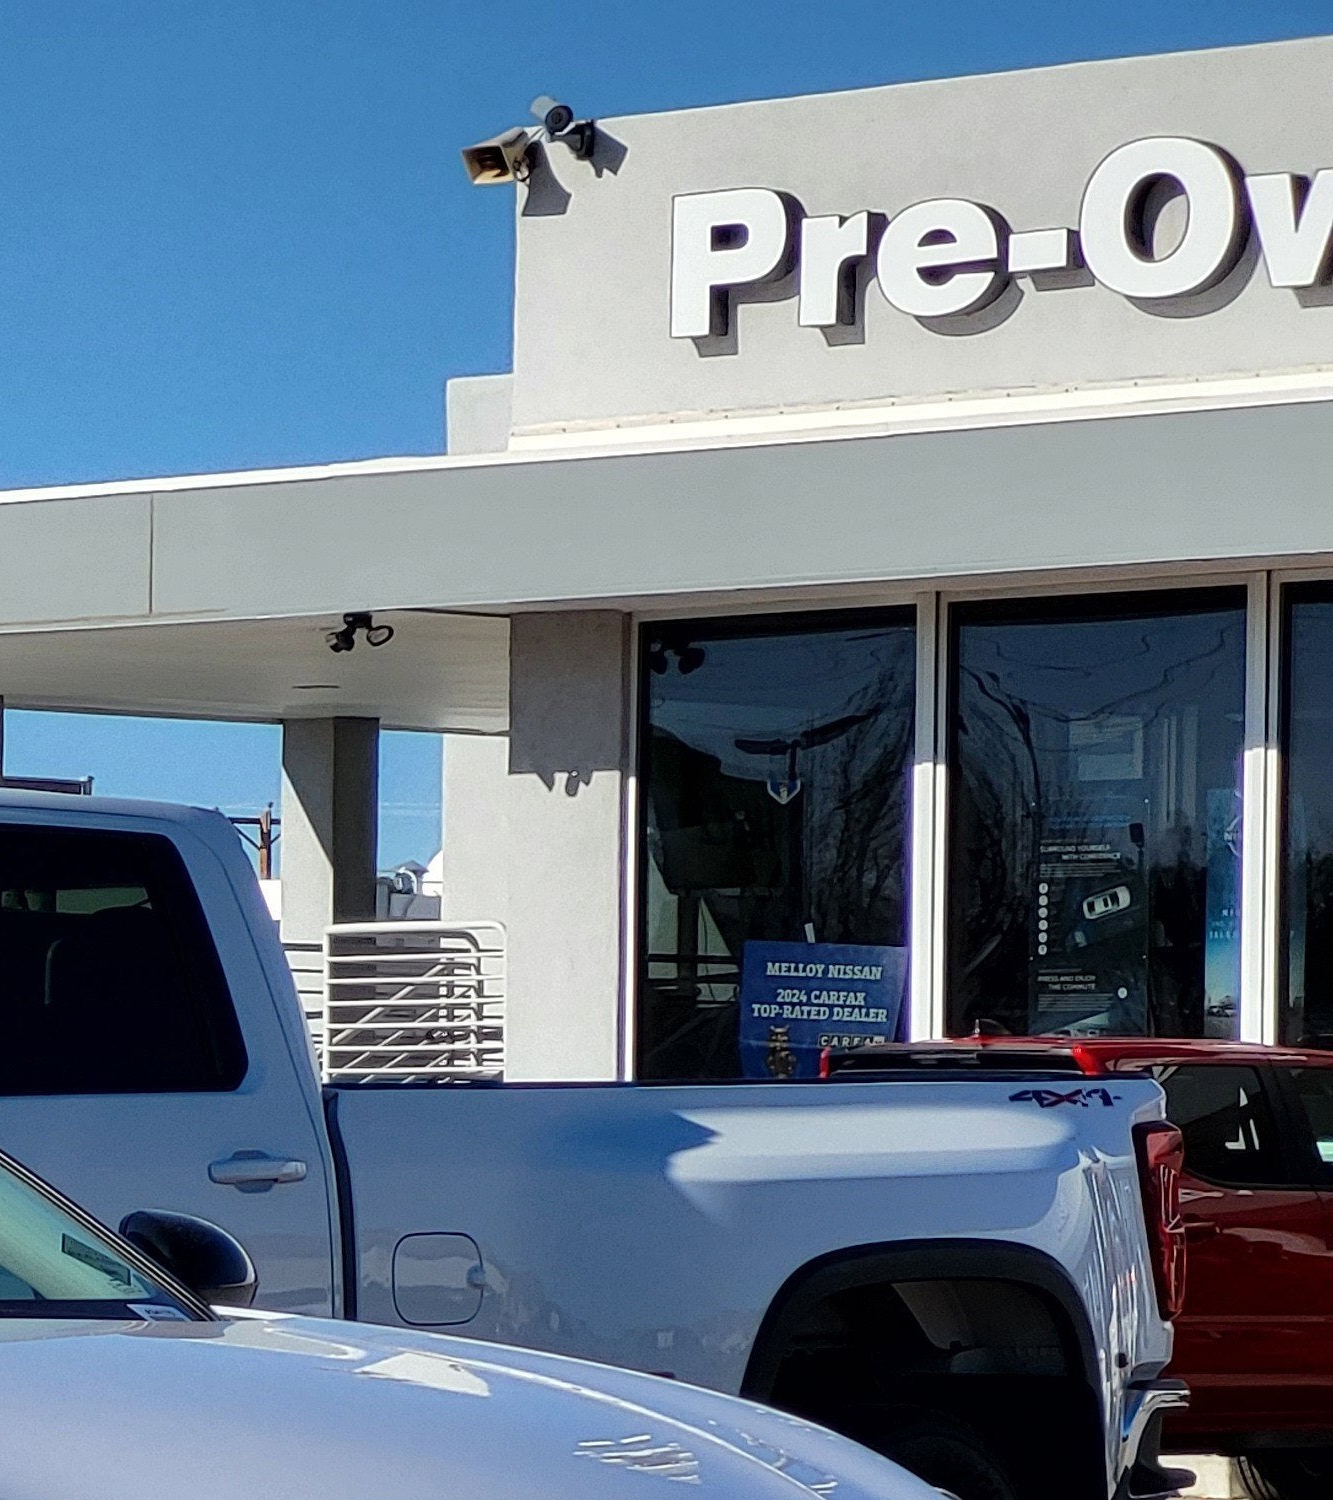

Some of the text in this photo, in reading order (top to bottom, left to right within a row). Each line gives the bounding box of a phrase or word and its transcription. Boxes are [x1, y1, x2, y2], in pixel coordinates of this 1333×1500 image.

[766, 962, 883, 981] MELLOY NISSAN
[776, 989, 867, 1006] 2024 CARFAX
[751, 1004, 888, 1023] TOP-RATED DEALER
